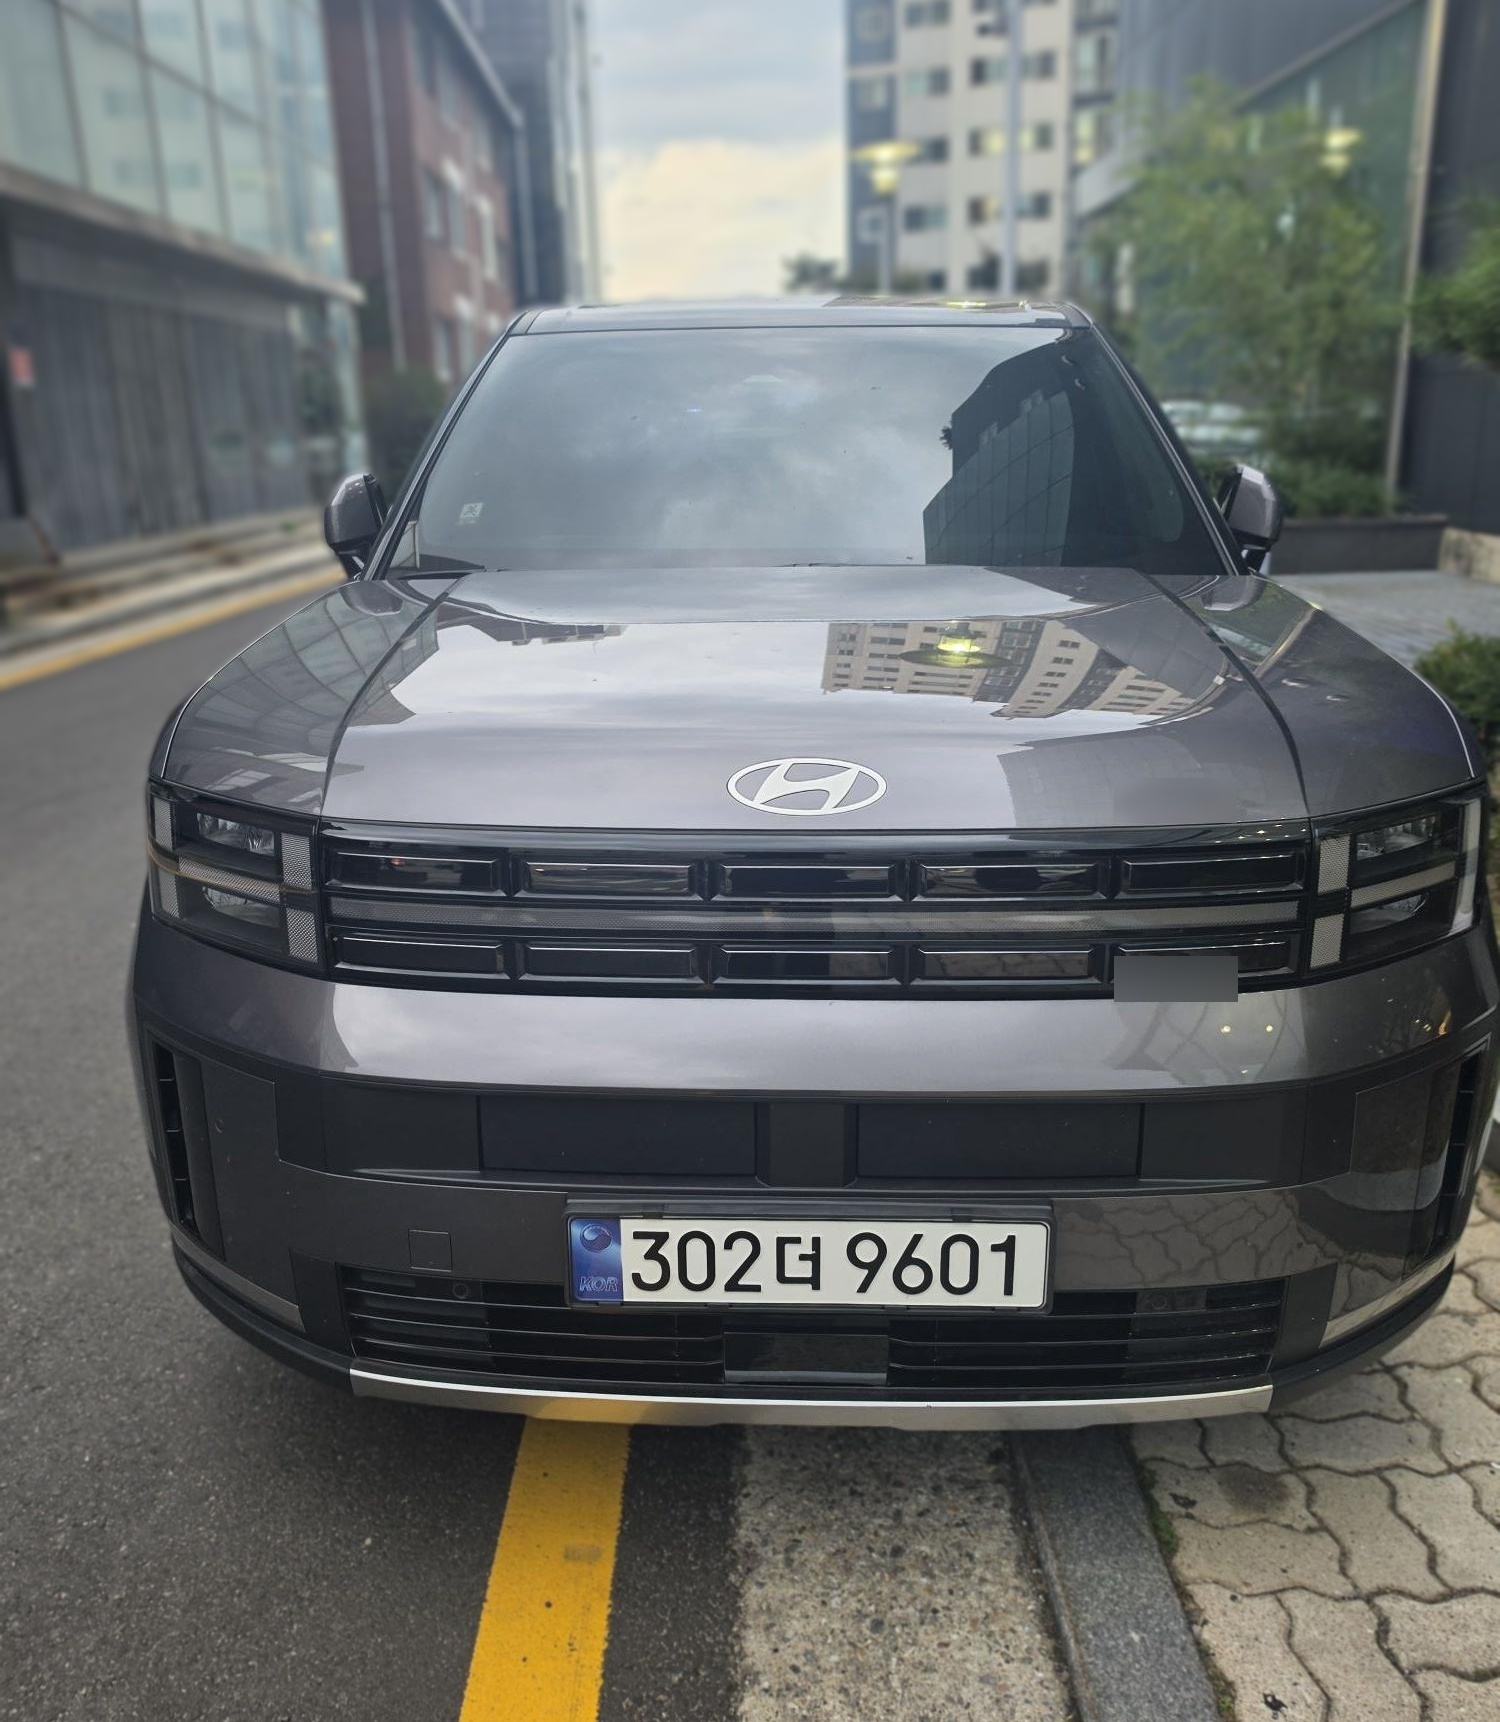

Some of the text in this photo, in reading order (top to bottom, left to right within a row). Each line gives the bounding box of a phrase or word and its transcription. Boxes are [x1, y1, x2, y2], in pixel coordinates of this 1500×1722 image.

[579, 1276, 618, 1293] KOR
[631, 1230, 1016, 1297] 302더 9601
